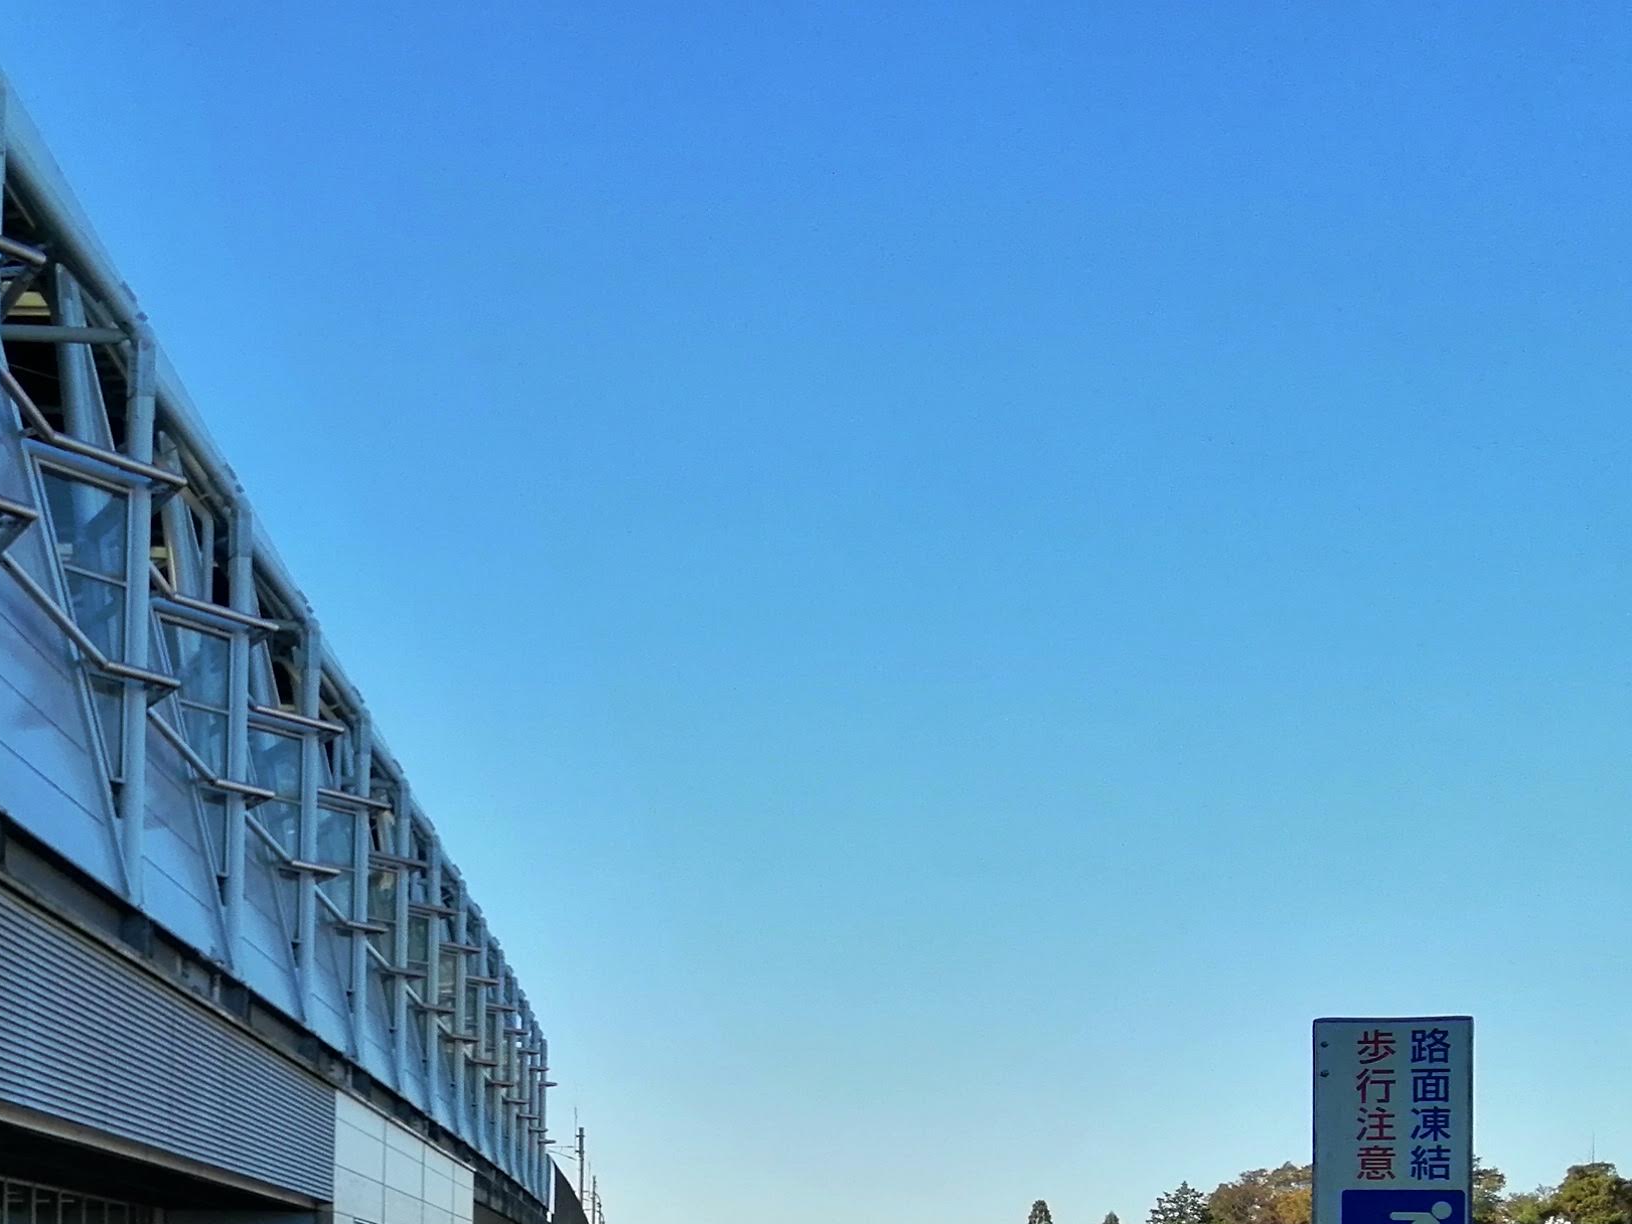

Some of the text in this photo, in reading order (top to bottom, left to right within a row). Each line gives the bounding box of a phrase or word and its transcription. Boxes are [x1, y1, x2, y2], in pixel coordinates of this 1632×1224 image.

[1356, 1030, 1396, 1181] 歩行注意
[1410, 1029, 1451, 1181] 路面凍結
